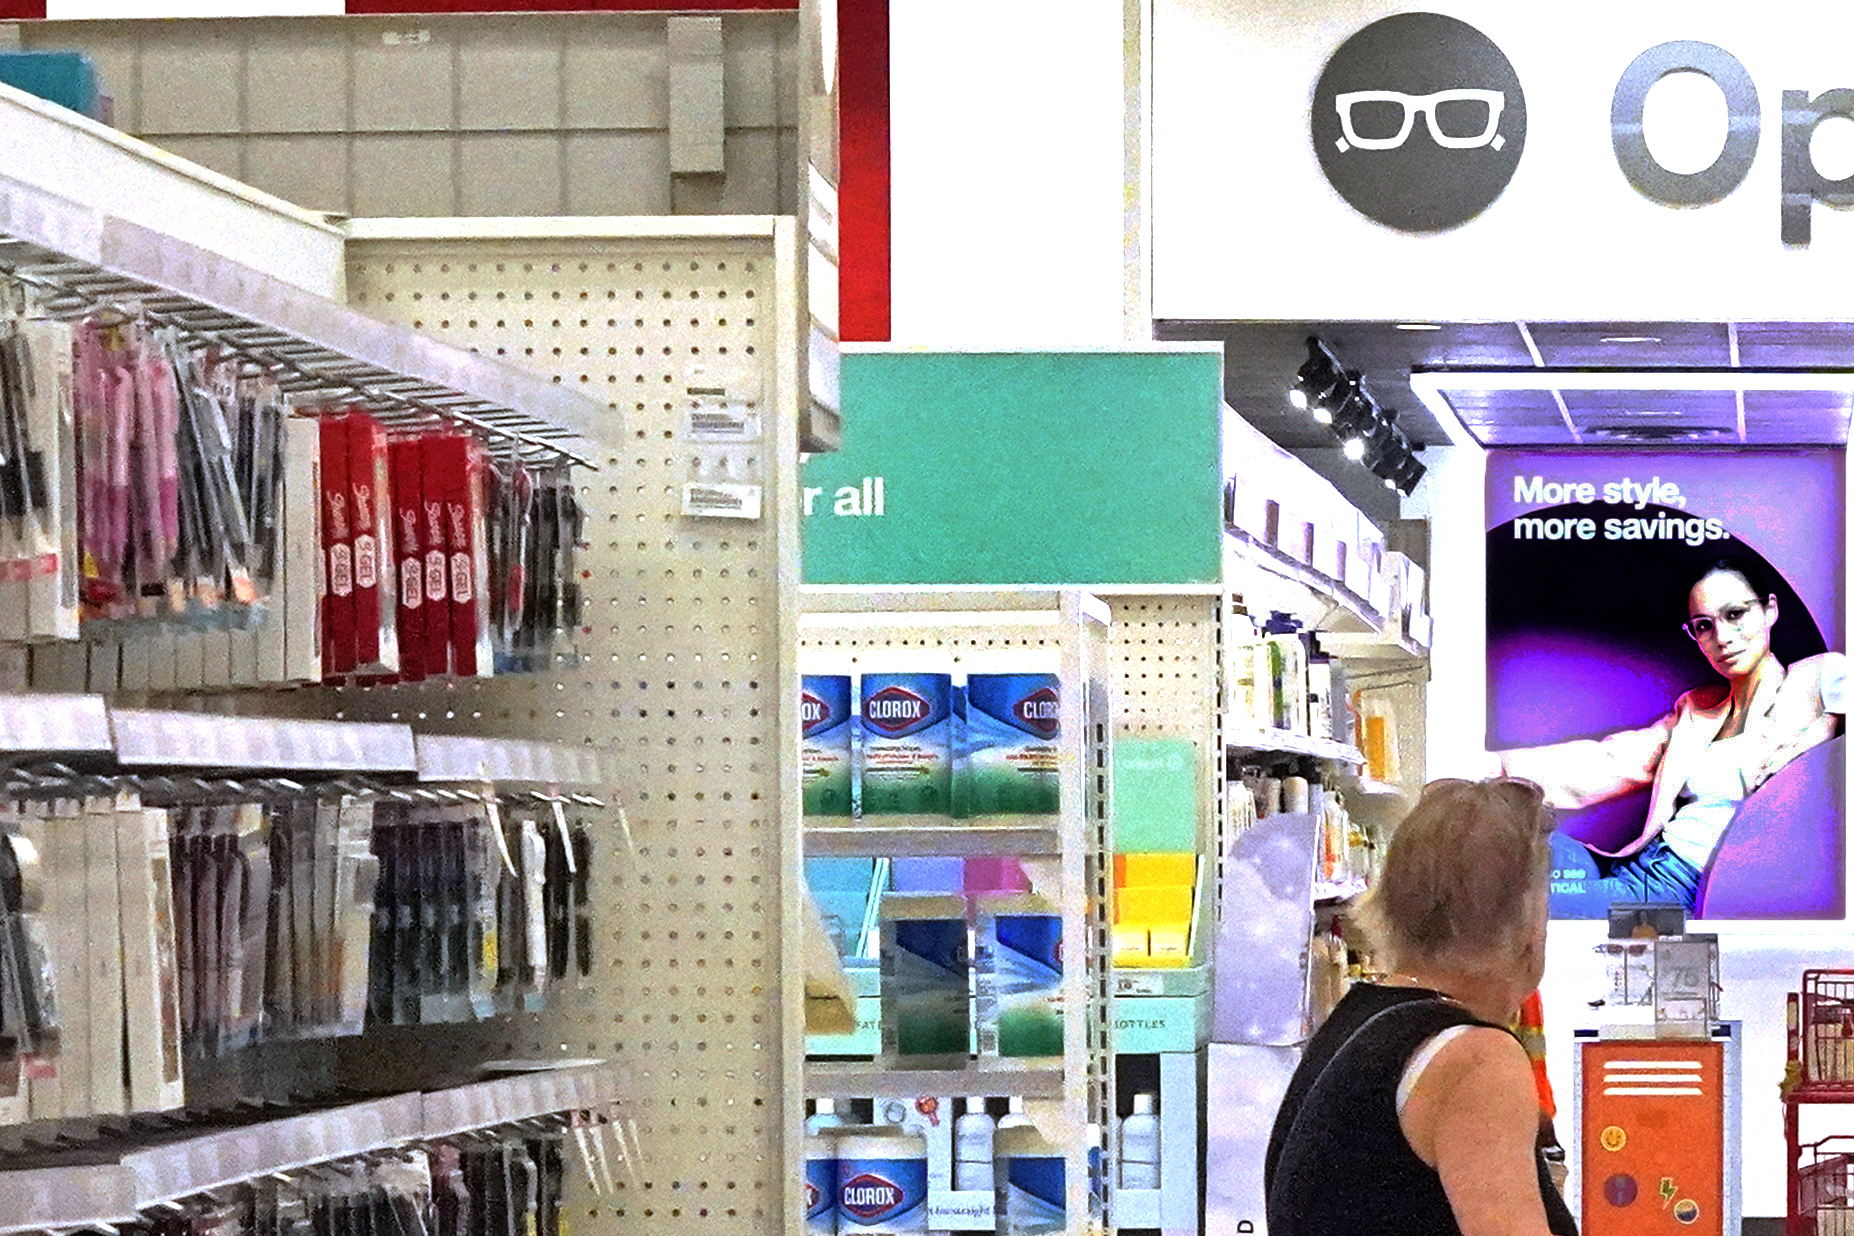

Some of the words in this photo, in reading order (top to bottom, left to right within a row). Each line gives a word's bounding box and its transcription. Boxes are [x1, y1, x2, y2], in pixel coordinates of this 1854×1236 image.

[833, 476, 885, 517] all
[1513, 475, 1595, 504] More
[1602, 475, 1686, 509] style,
[1513, 517, 1596, 541] more
[1603, 513, 1731, 546] savings.
[869, 700, 921, 719] CLOROX
[1550, 869, 1561, 879] o
[844, 1187, 895, 1206] CLOROX
